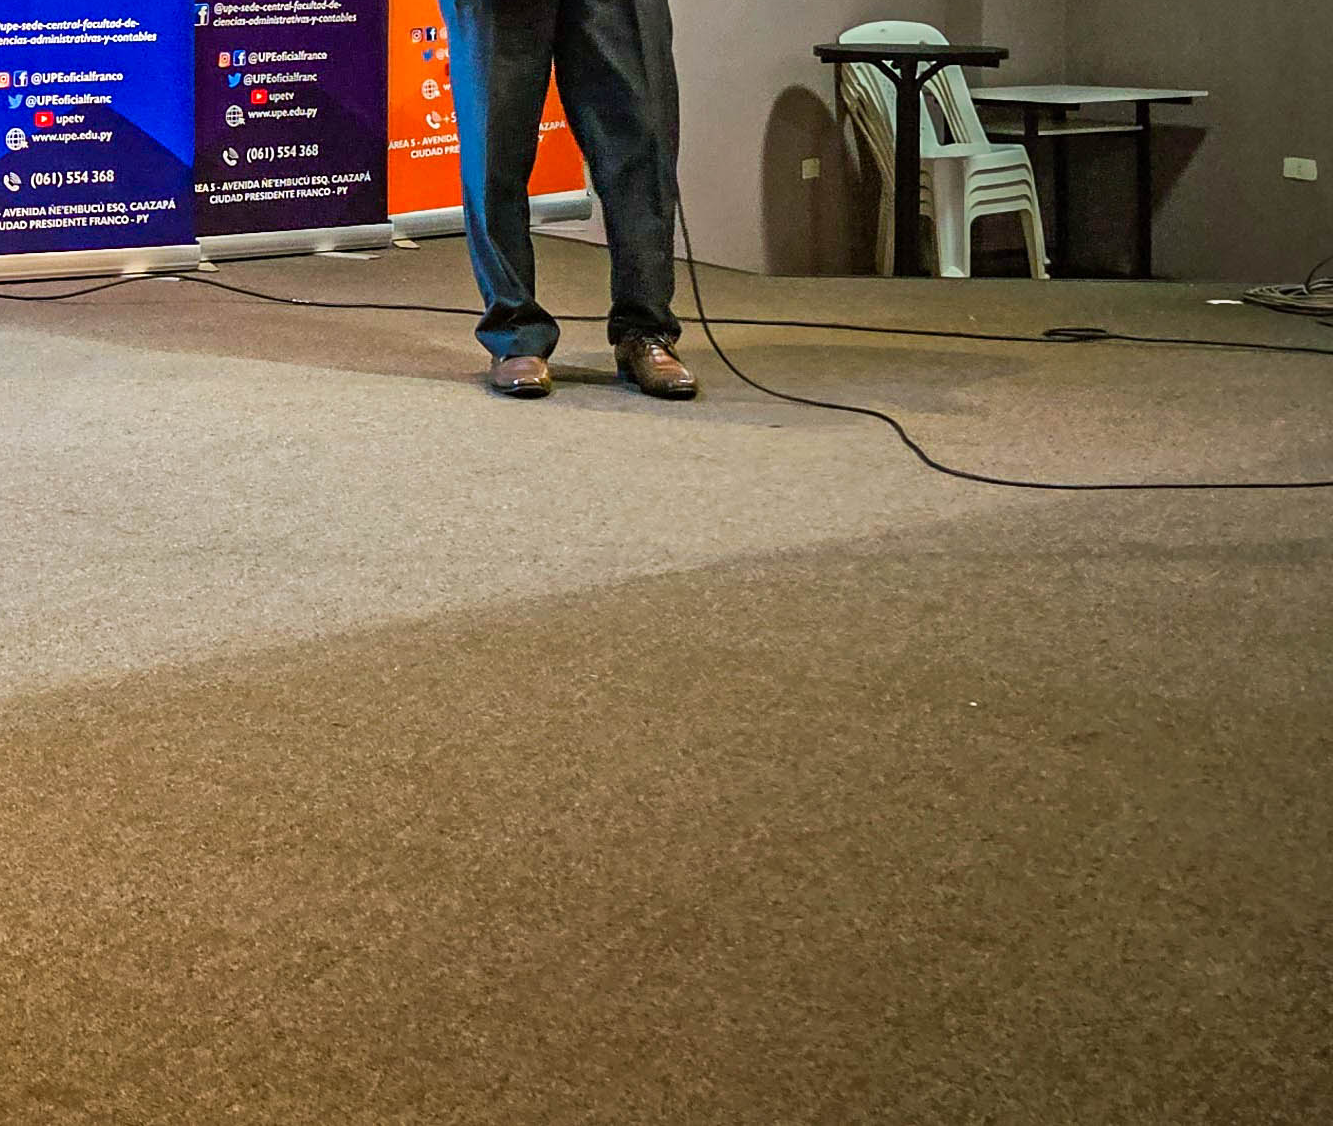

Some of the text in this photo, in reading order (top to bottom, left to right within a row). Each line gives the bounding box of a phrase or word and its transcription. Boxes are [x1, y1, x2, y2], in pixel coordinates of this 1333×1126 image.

[31, 72, 123, 85] @UPEoficialfranco
[26, 94, 112, 107] @UPEoficialfranc
[56, 114, 84, 125] upetv
[32, 130, 112, 143] www.upe.edu.py
[247, 145, 319, 163] (061) 554 368
[31, 170, 114, 189] (061) 554 368
[3, 206, 46, 217] AVENIDA
[107, 203, 128, 214] ESQ.
[130, 198, 175, 211] CAAZAPÁ
[29, 218, 87, 230] PRESIDENTE
[89, 215, 128, 227] FRANCO
[136, 214, 149, 224] PY
